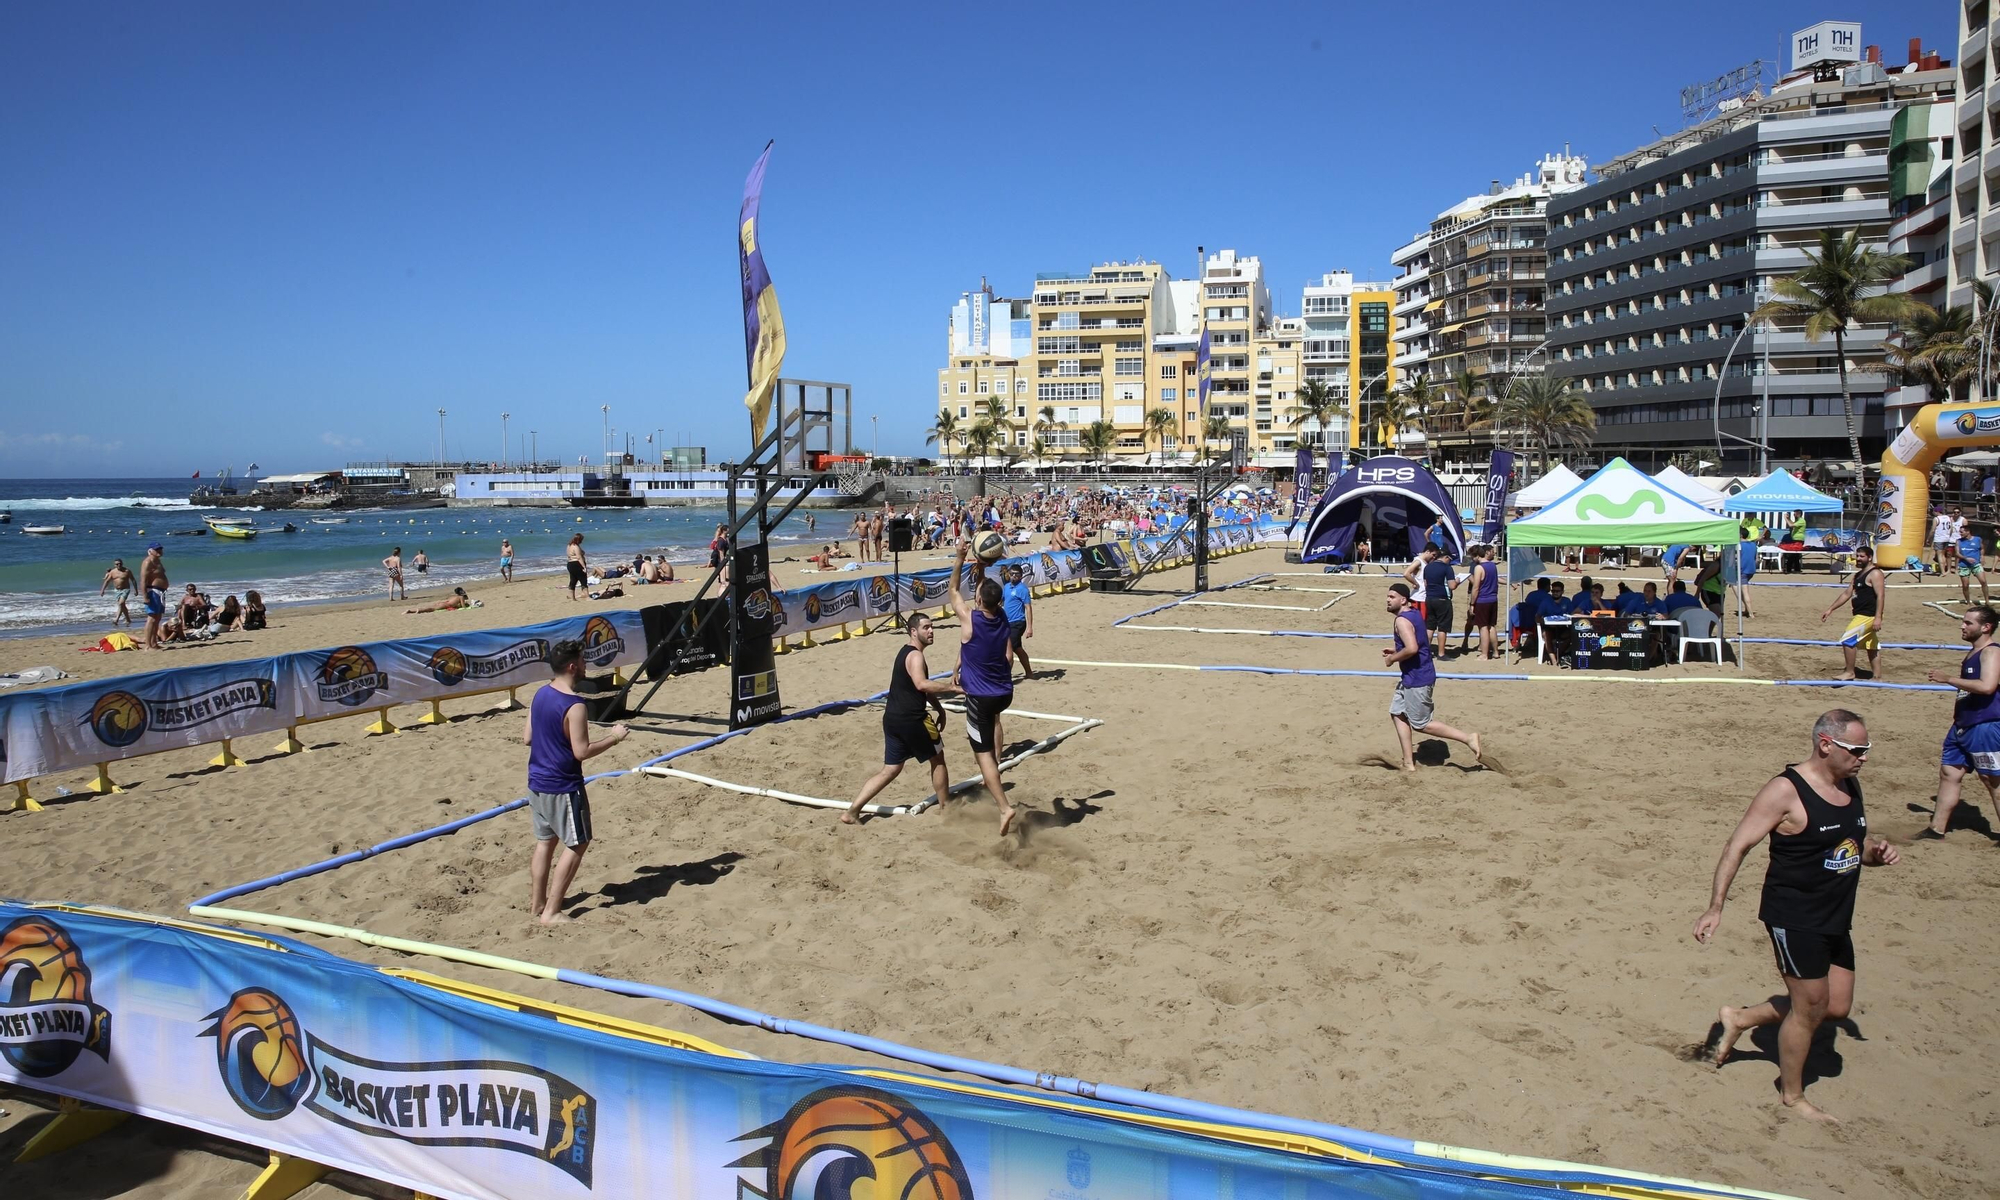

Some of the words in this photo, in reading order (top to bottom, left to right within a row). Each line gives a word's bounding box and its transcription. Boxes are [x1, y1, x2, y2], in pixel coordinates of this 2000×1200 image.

[1798, 48, 1819, 60] HOTELS
[1357, 467, 1415, 481] HPS
[1294, 473, 1308, 519] HPS
[1485, 474, 1504, 523] HPS
[752, 554, 759, 567] 2
[472, 654, 509, 675] BASKET
[510, 644, 538, 665] PLAYA
[602, 641, 618, 653] PLAYA
[321, 683, 350, 699] BASKET
[351, 676, 375, 690] PLAYA
[155, 698, 212, 725] BASKET
[212, 686, 257, 711] PLAYA
[1825, 861, 1847, 869] BASKET
[1847, 856, 1859, 865] PLAYA
[0, 1013, 31, 1037] KET
[31, 1009, 85, 1036] PLAYA
[321, 1064, 430, 1128] BASKET
[437, 1083, 539, 1137] PLAYA
[572, 1107, 587, 1164] ACB
